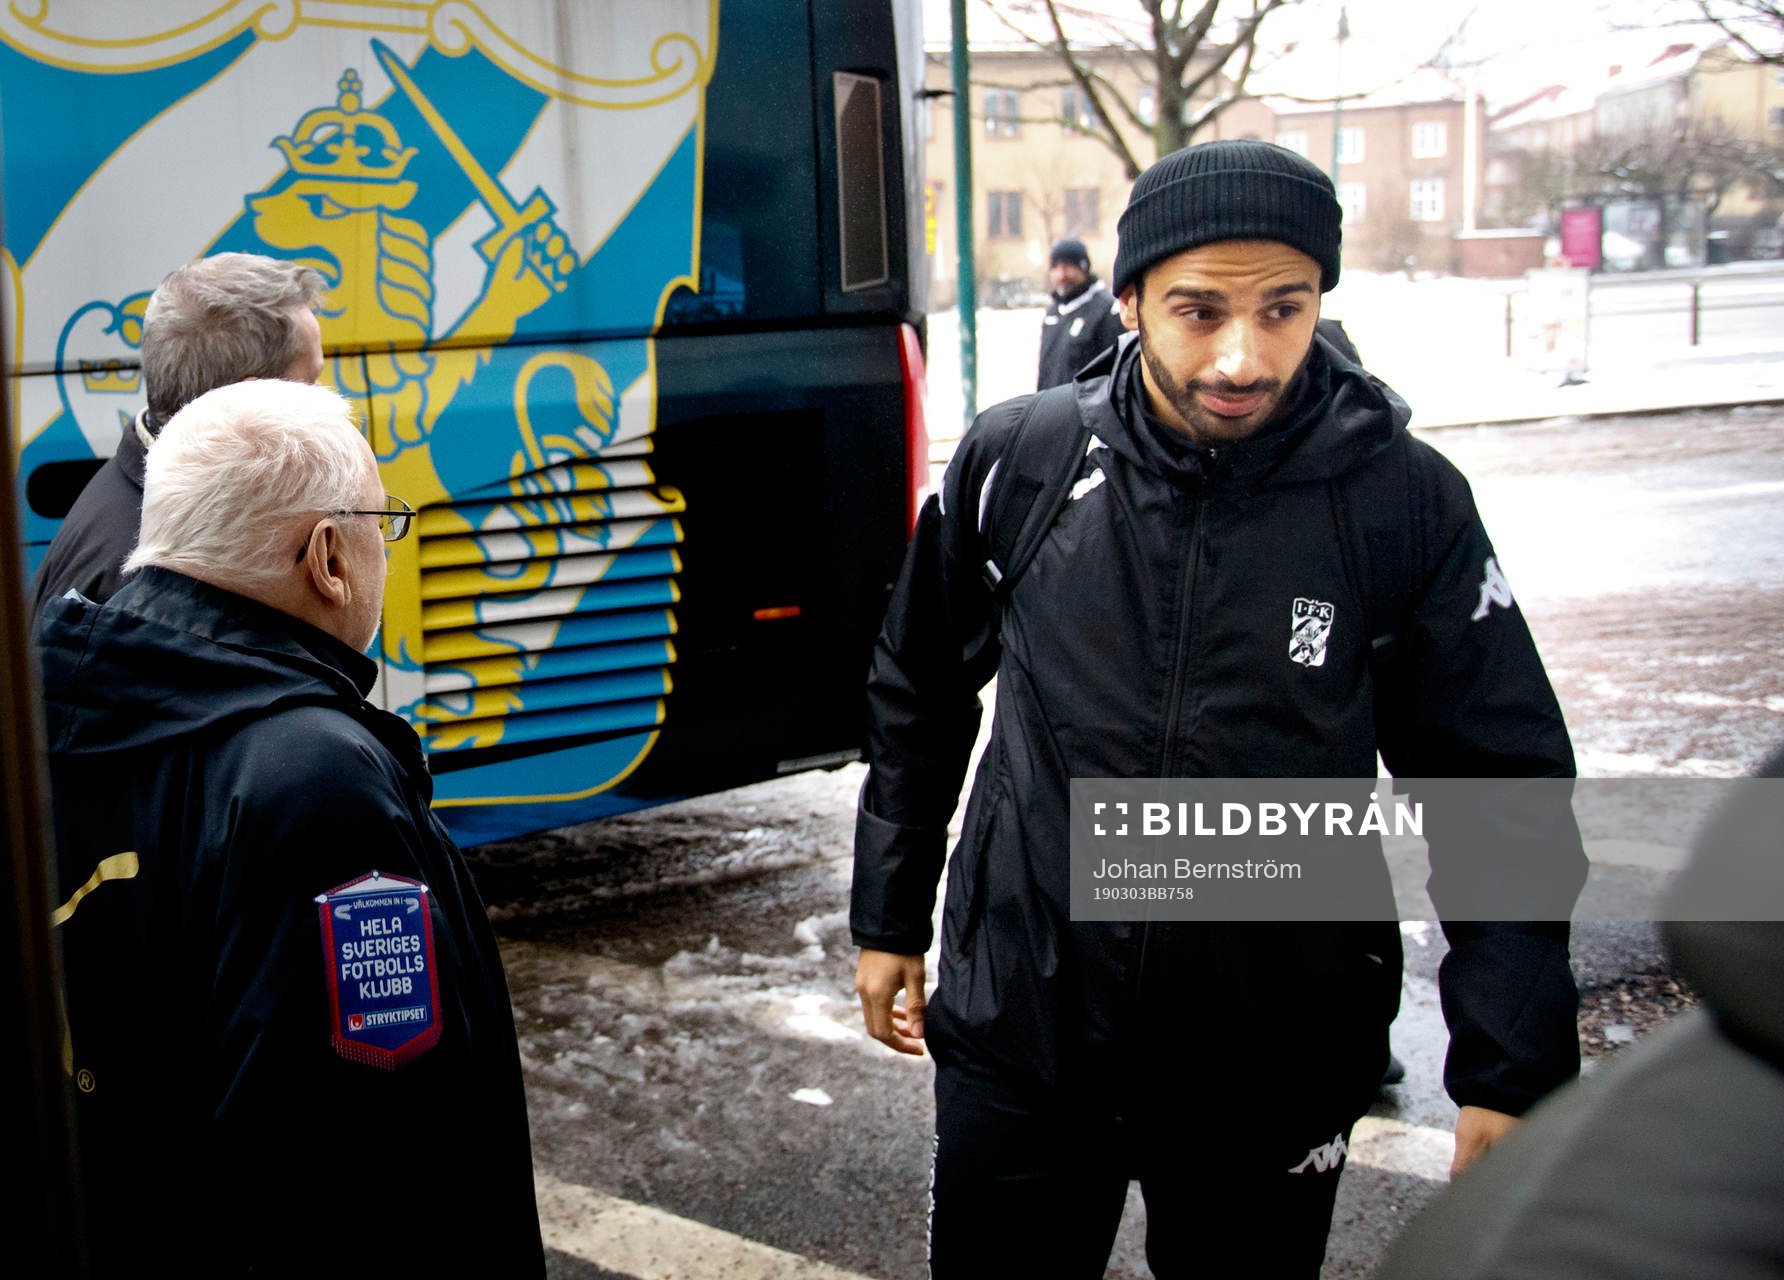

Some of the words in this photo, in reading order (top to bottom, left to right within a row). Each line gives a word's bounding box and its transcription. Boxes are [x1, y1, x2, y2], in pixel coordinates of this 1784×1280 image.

[360, 916, 402, 937] HELA
[342, 935, 420, 960] SVERIGES
[341, 954, 424, 981] FOTBOLLS
[359, 976, 413, 1000] KLUBB
[366, 1007, 425, 1026] STRYKTIPSET
